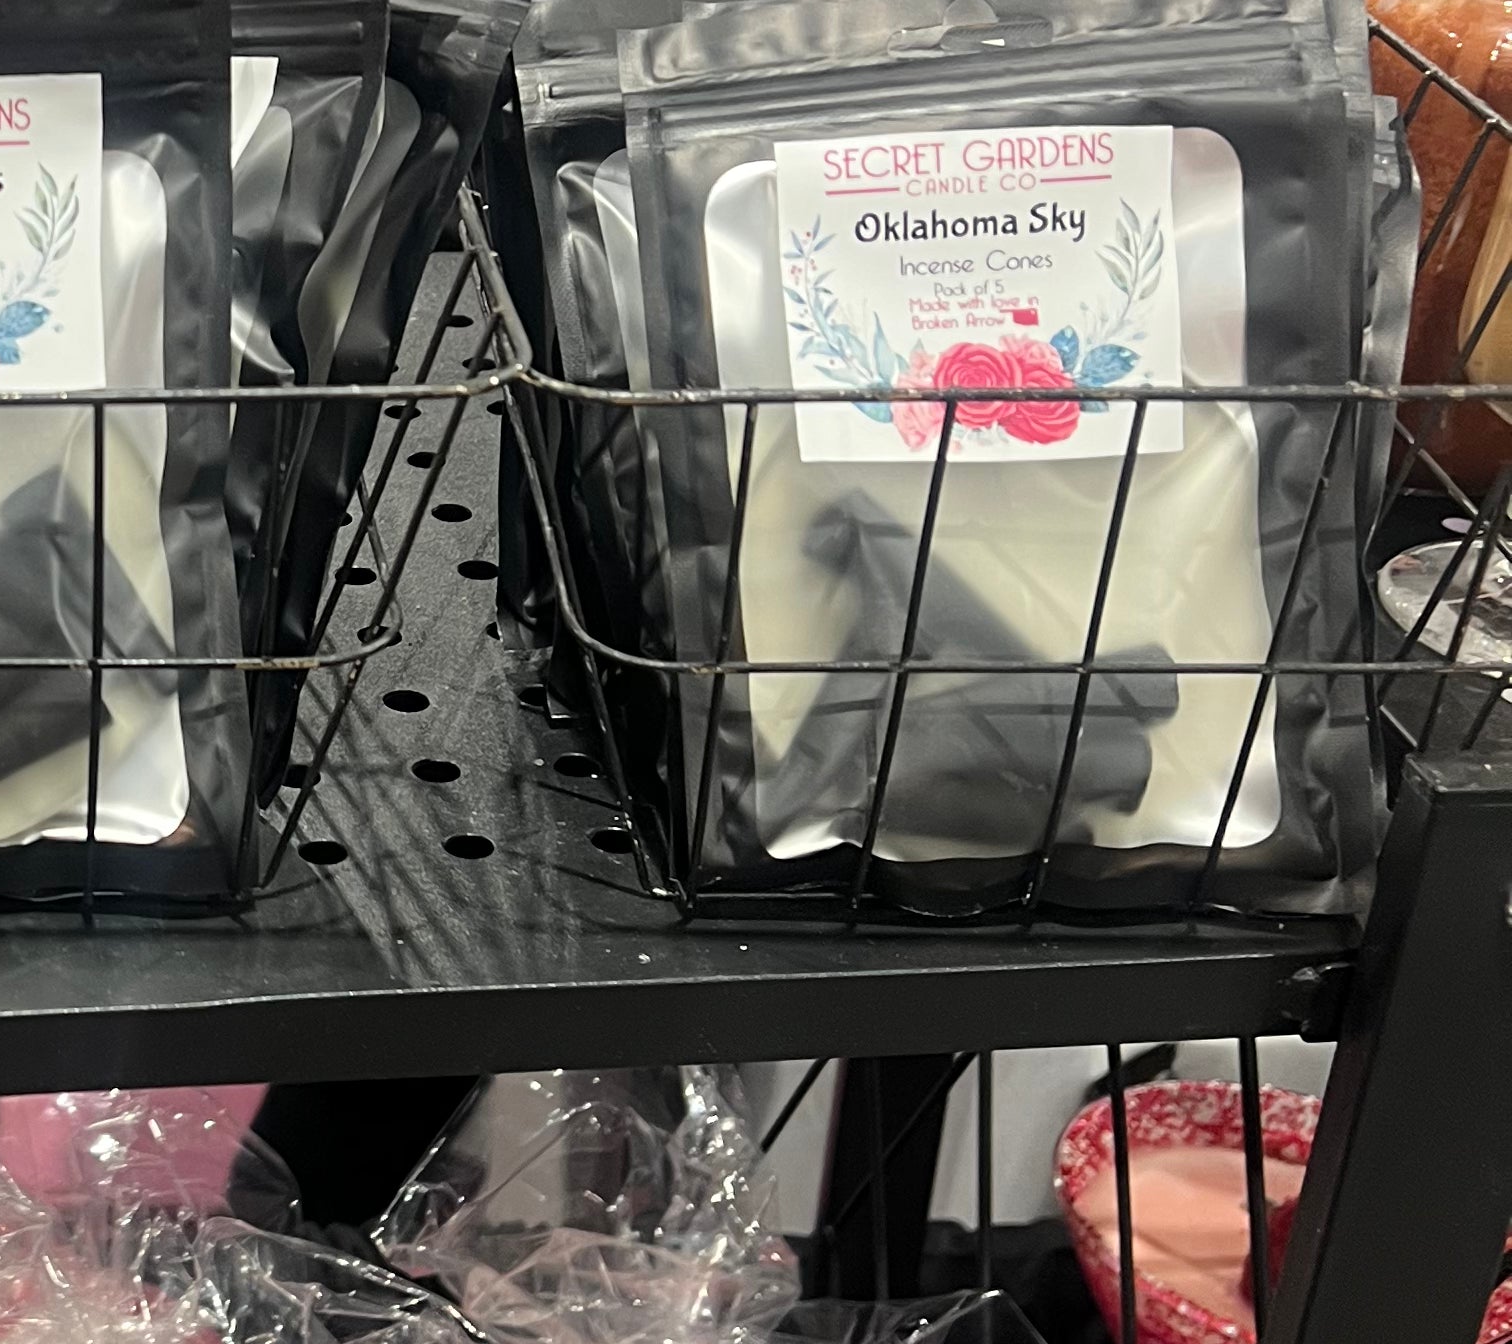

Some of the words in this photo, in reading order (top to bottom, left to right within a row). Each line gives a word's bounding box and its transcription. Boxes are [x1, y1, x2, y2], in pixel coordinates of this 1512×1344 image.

[824, 143, 945, 181] SECRET
[963, 132, 1114, 172] GARDENS
[906, 176, 988, 197] CANDLE
[1000, 173, 1036, 191] CO
[855, 209, 1018, 243] Oklahoma
[1029, 202, 1086, 243] Sky
[900, 256, 975, 276] Incense
[986, 249, 1053, 271] Cones
[934, 282, 966, 297] Pack
[974, 279, 989, 296] of
[995, 279, 1004, 294] 5
[909, 298, 950, 313] Made
[958, 297, 985, 309] with
[991, 296, 1021, 308] love
[1028, 296, 1039, 308] in
[911, 314, 958, 331] Broken
[966, 313, 1005, 327] Arrow
